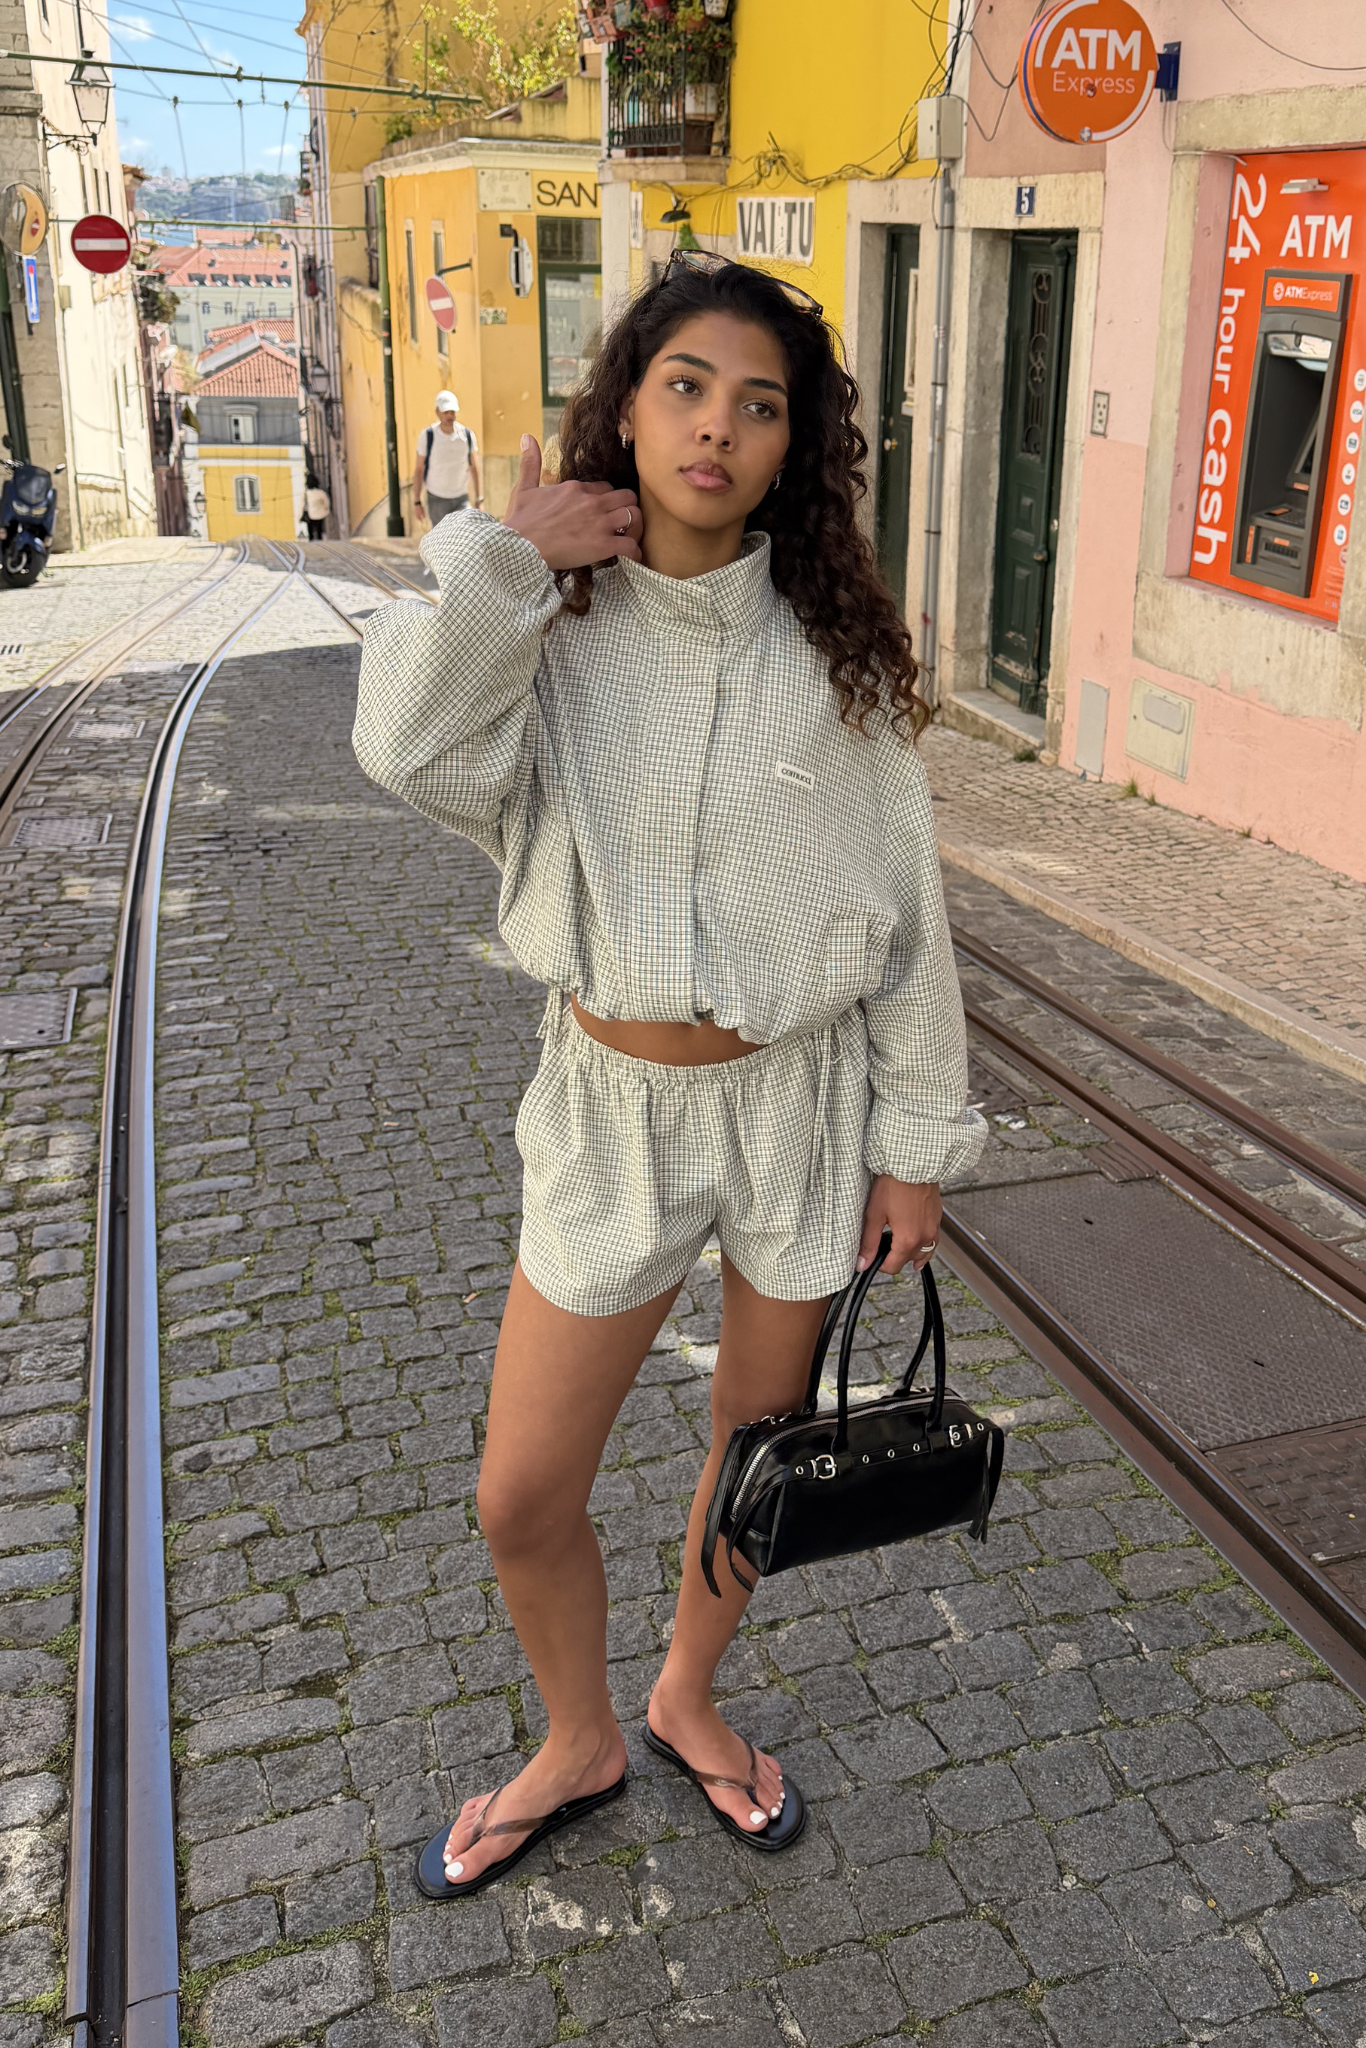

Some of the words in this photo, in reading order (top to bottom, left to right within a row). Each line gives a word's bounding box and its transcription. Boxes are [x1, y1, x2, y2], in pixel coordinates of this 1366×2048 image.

[1050, 27, 1142, 71] ATM
[1052, 70, 1136, 97] Express
[1021, 187, 1030, 214] 5
[1228, 173, 1268, 265] 24
[1279, 214, 1353, 259] ATM
[1214, 287, 1246, 394] hour
[1193, 408, 1233, 565] cash
